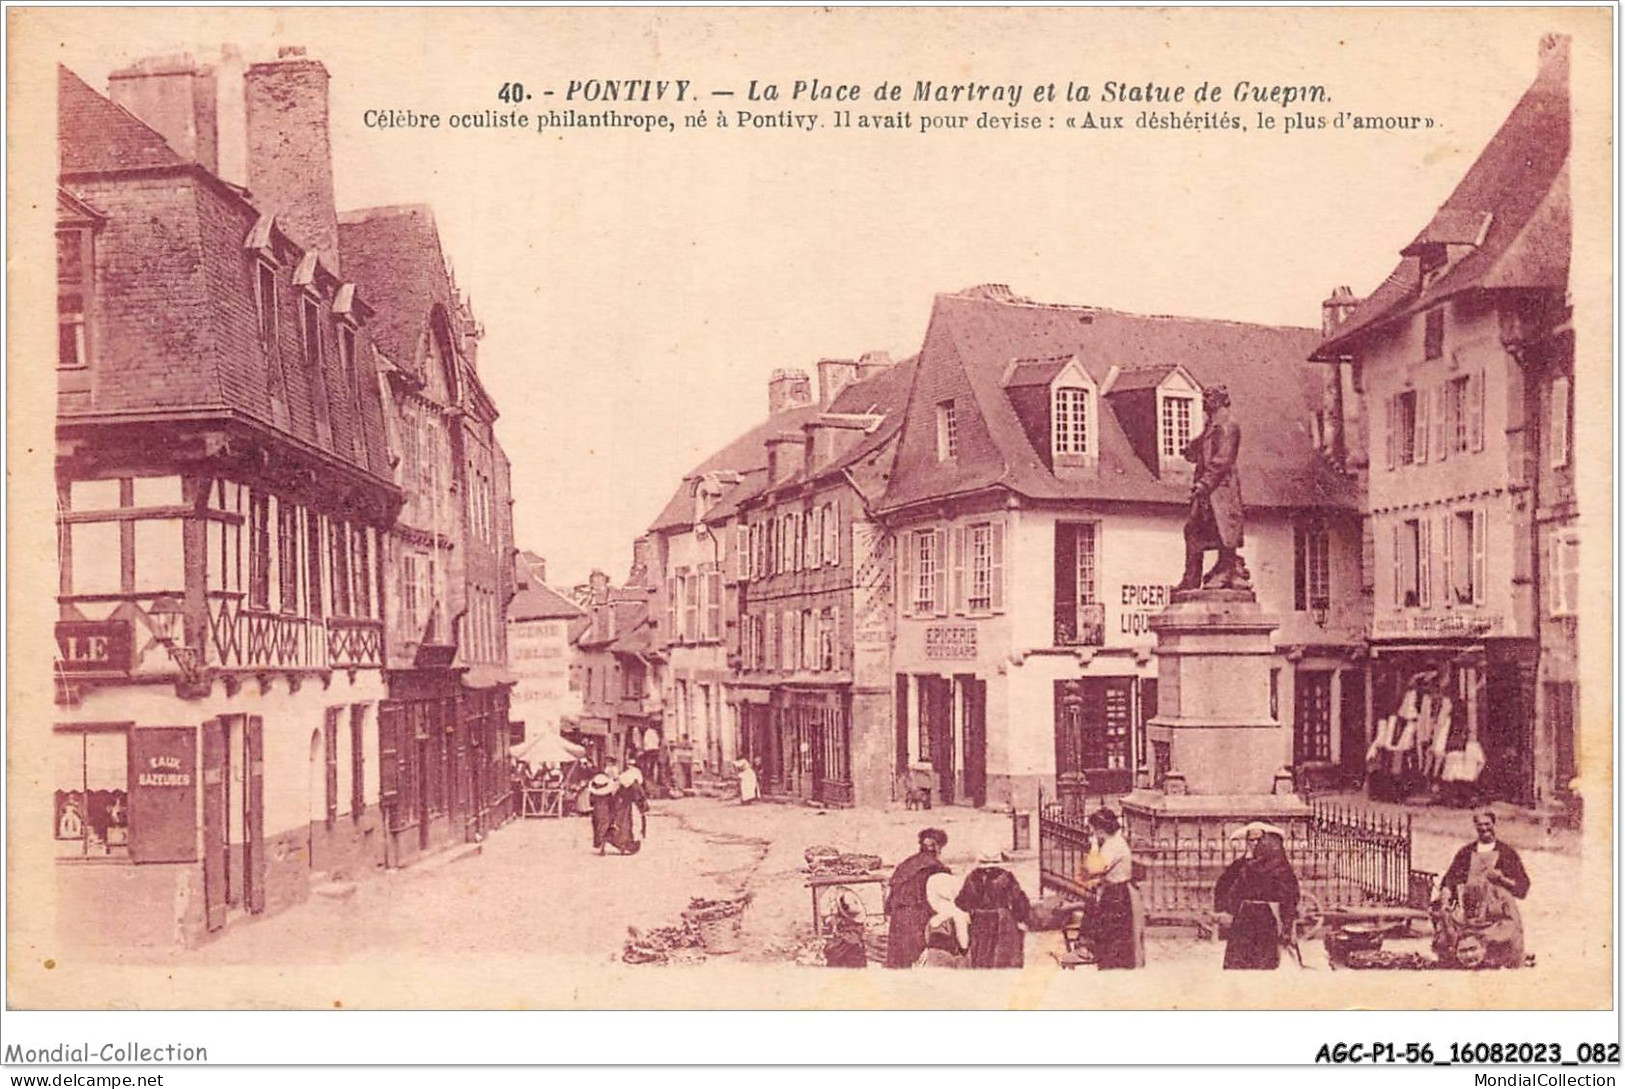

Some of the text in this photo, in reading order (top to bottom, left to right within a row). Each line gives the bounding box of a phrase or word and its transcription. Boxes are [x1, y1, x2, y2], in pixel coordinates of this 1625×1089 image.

[1121, 584, 1170, 606] EPICERI
[1121, 613, 1149, 636] LIQU
[925, 627, 977, 645] EPICERIE
[67, 635, 109, 661] LE
[149, 756, 182, 770] EAUX
